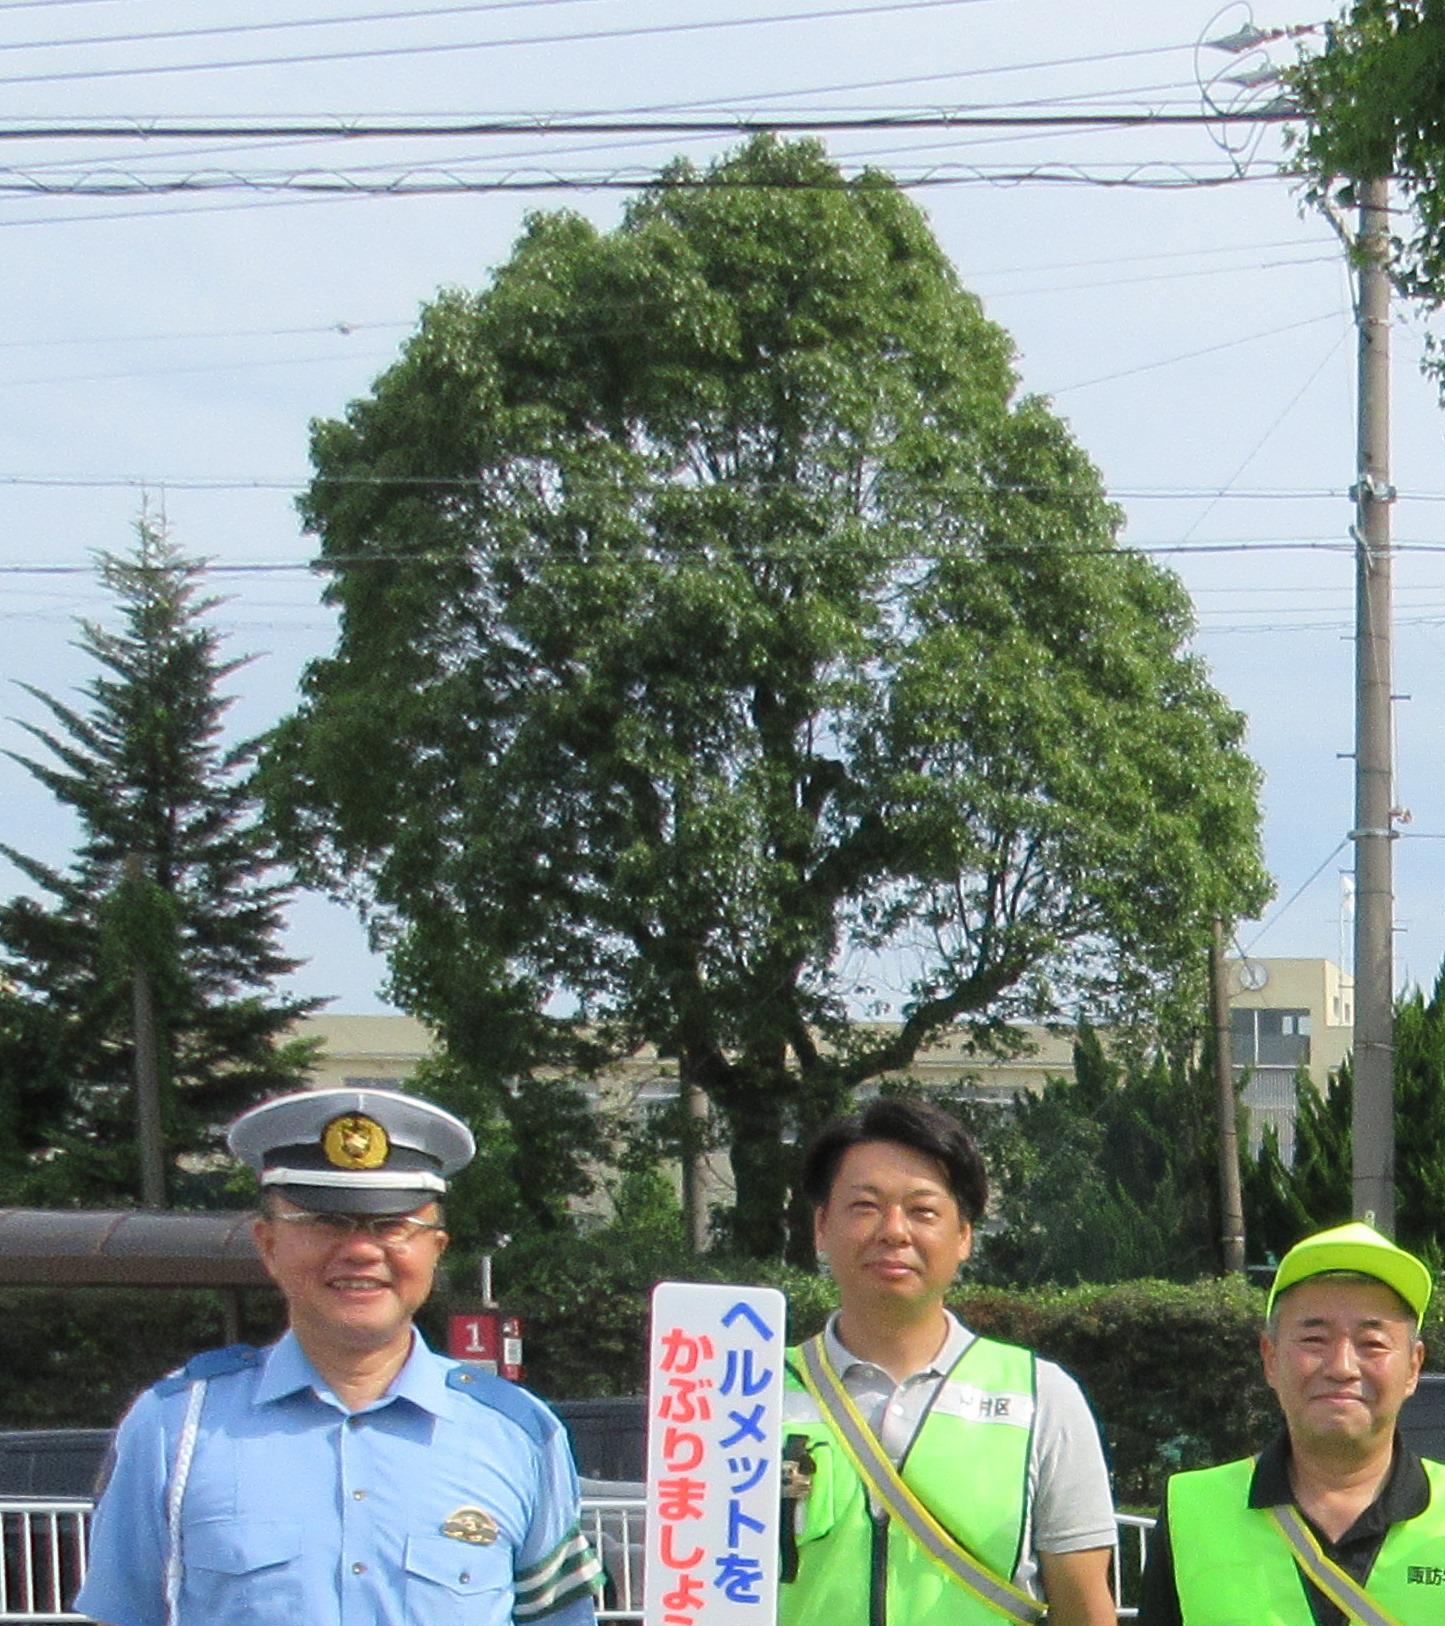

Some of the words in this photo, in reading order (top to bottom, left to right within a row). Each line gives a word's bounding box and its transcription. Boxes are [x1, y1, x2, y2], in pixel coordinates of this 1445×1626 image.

[465, 1322, 486, 1353] 1
[713, 1301, 775, 1605] ヘルメットを
